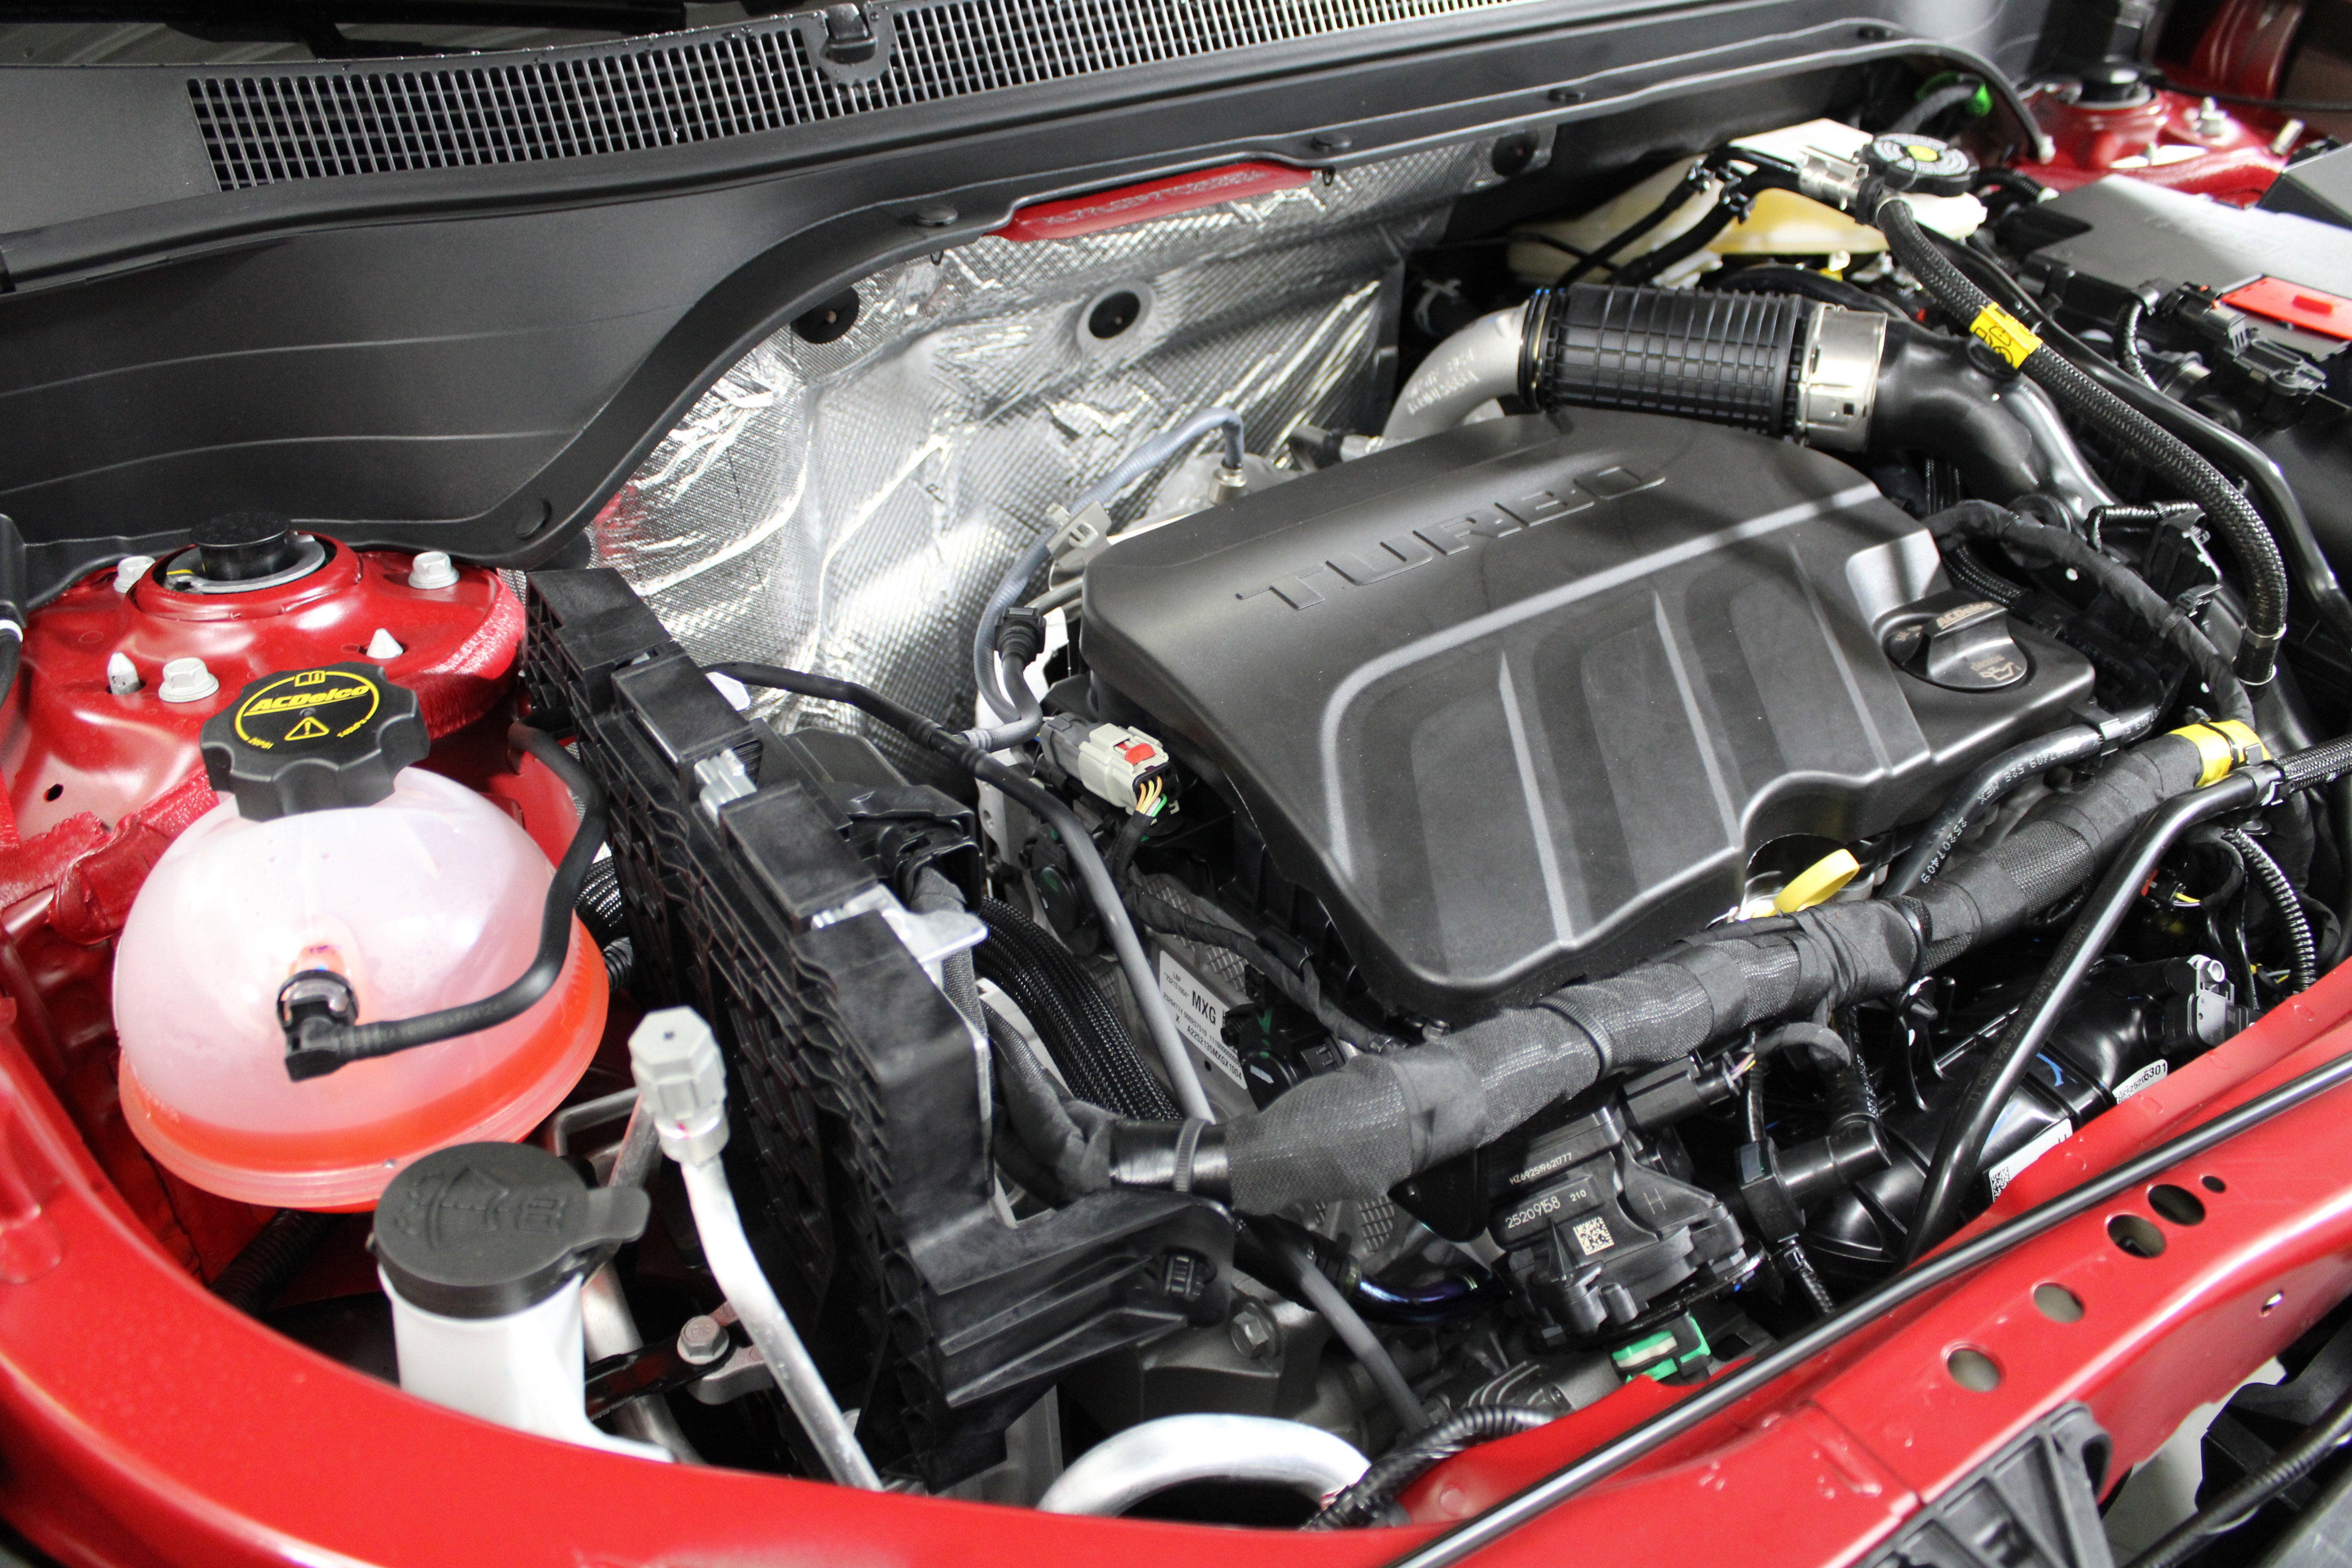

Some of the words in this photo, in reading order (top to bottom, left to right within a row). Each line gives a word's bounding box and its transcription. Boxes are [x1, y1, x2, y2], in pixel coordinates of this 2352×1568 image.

[1235, 466, 1666, 610] TURBO
[248, 685, 370, 712] ACDelco
[1176, 1014, 1180, 1024] X
[1192, 990, 1216, 1026] MXG
[1505, 1196, 1561, 1229] 25209158
[1570, 1189, 1587, 1202] 210
